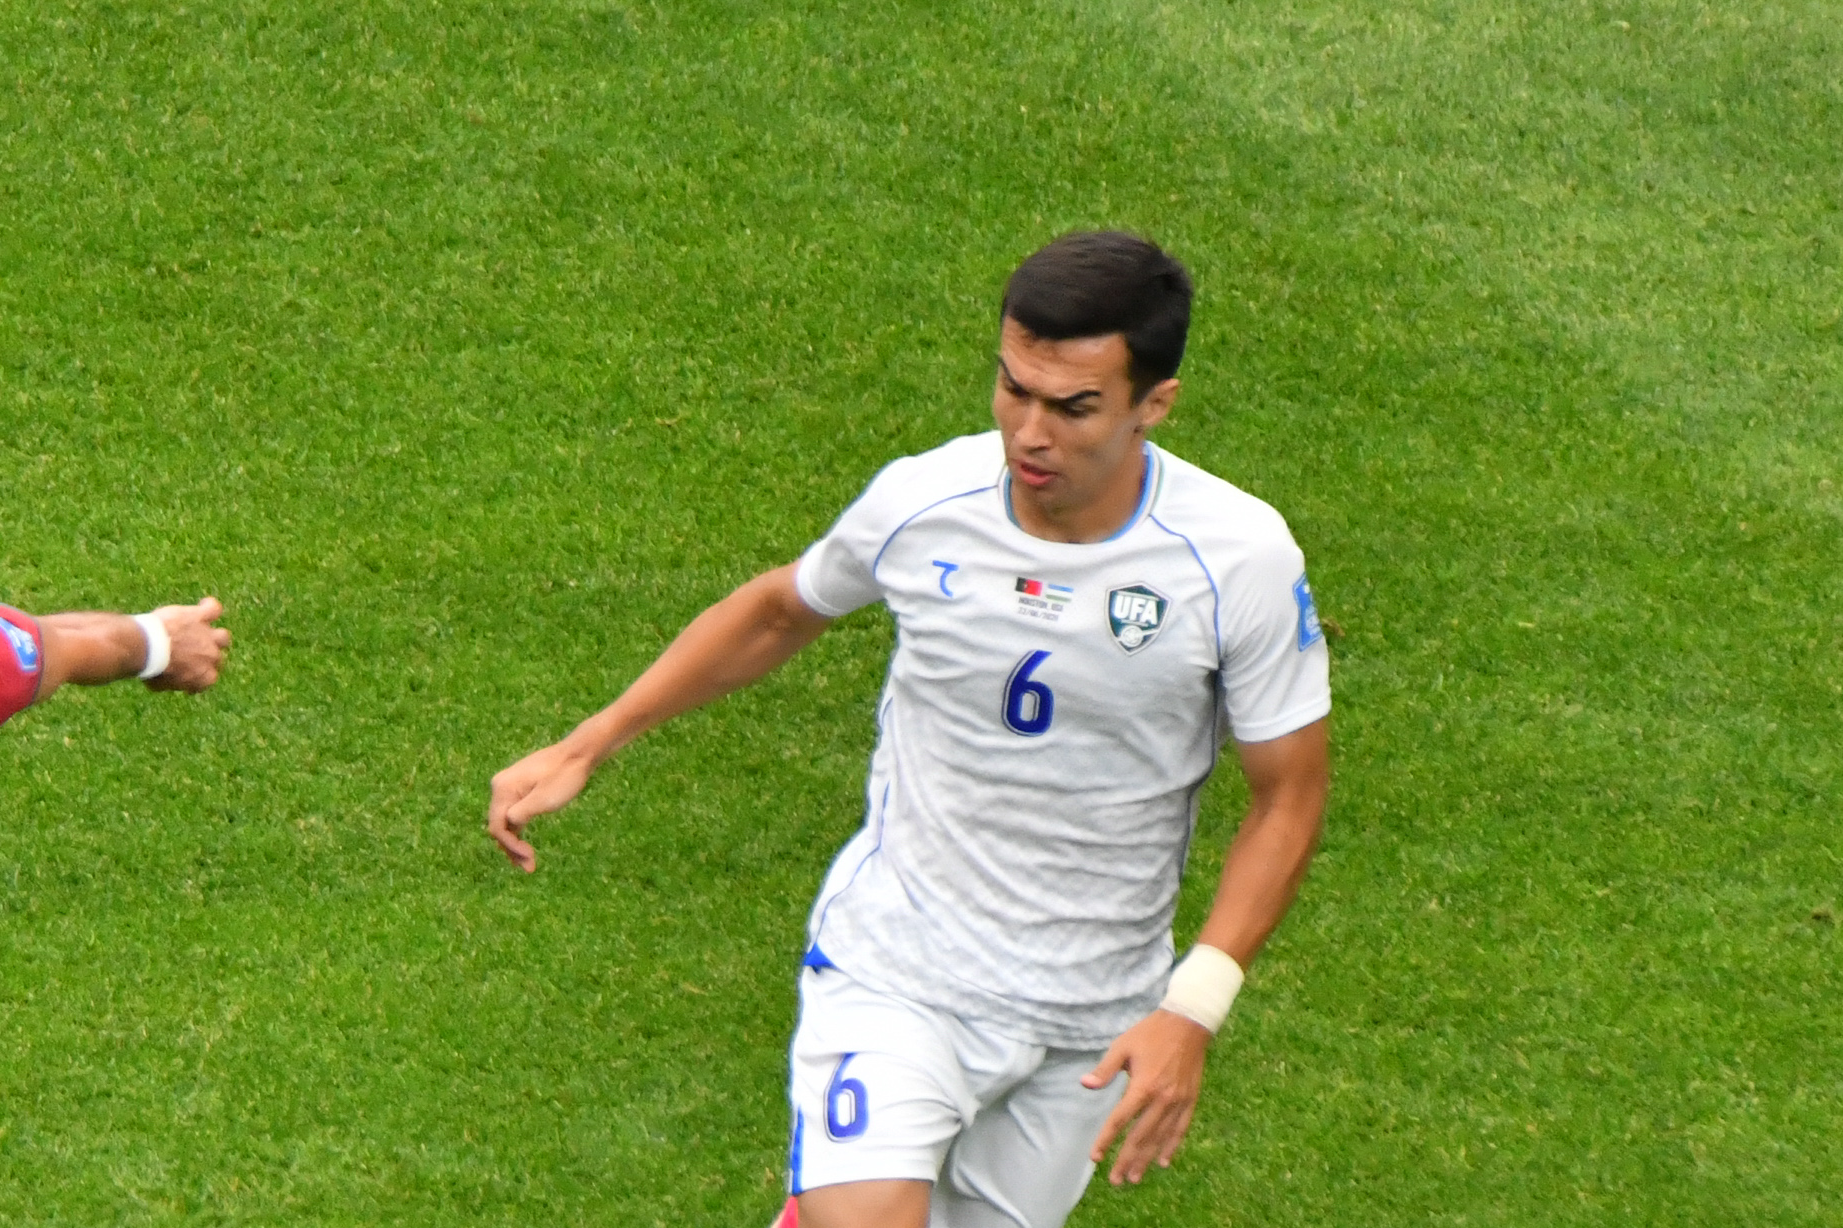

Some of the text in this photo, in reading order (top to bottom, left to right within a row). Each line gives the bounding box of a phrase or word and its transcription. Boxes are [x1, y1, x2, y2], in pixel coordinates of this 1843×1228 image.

[1113, 594, 1158, 626] UFA
[1002, 649, 1054, 737] 6
[823, 1051, 869, 1144] 6
